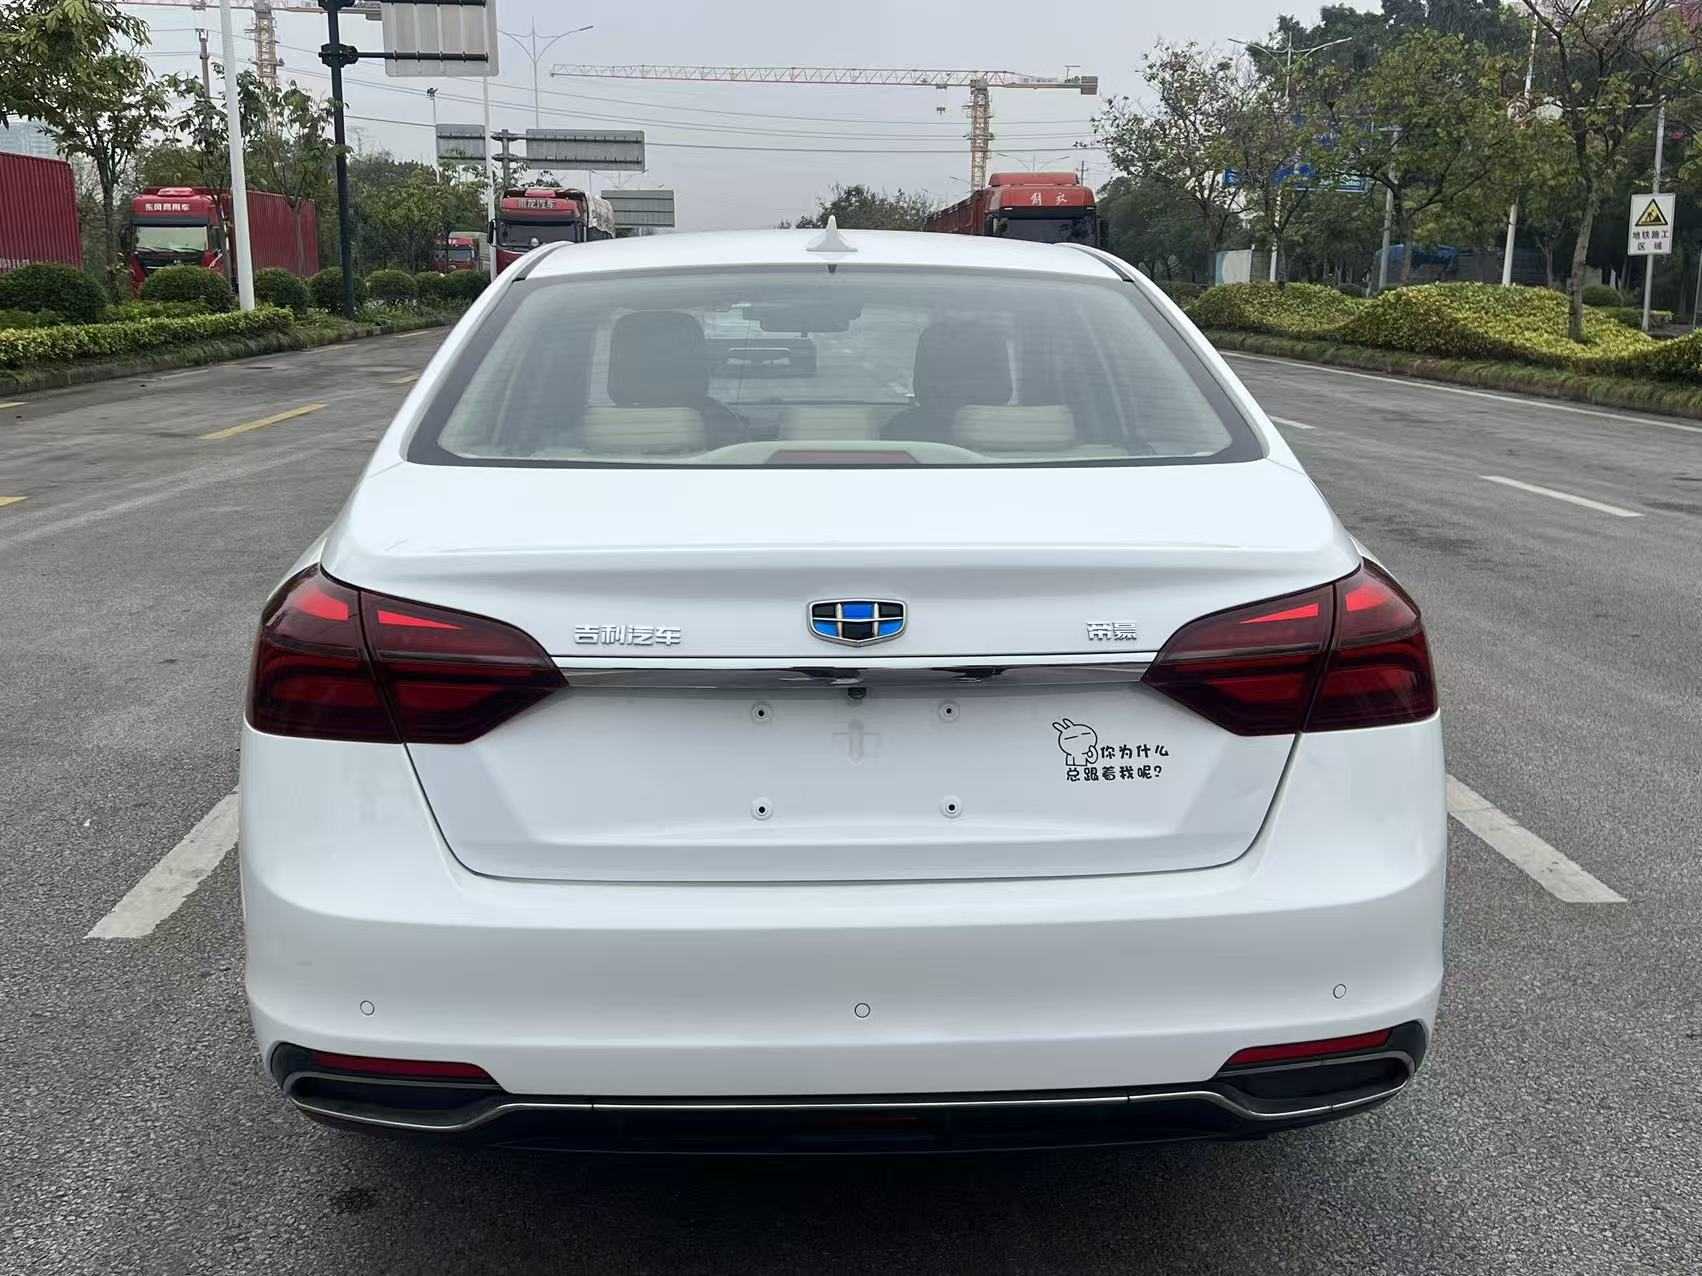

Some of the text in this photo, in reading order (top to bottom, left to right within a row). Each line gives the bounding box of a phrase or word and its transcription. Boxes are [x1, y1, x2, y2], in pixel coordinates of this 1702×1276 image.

[1632, 230, 1669, 239] 地铁施工
[1637, 242, 1662, 250] 区域
[575, 624, 681, 646] 吉利汽车
[1087, 620, 1137, 641] 帝豪
[1100, 744, 1170, 759] 你为什么
